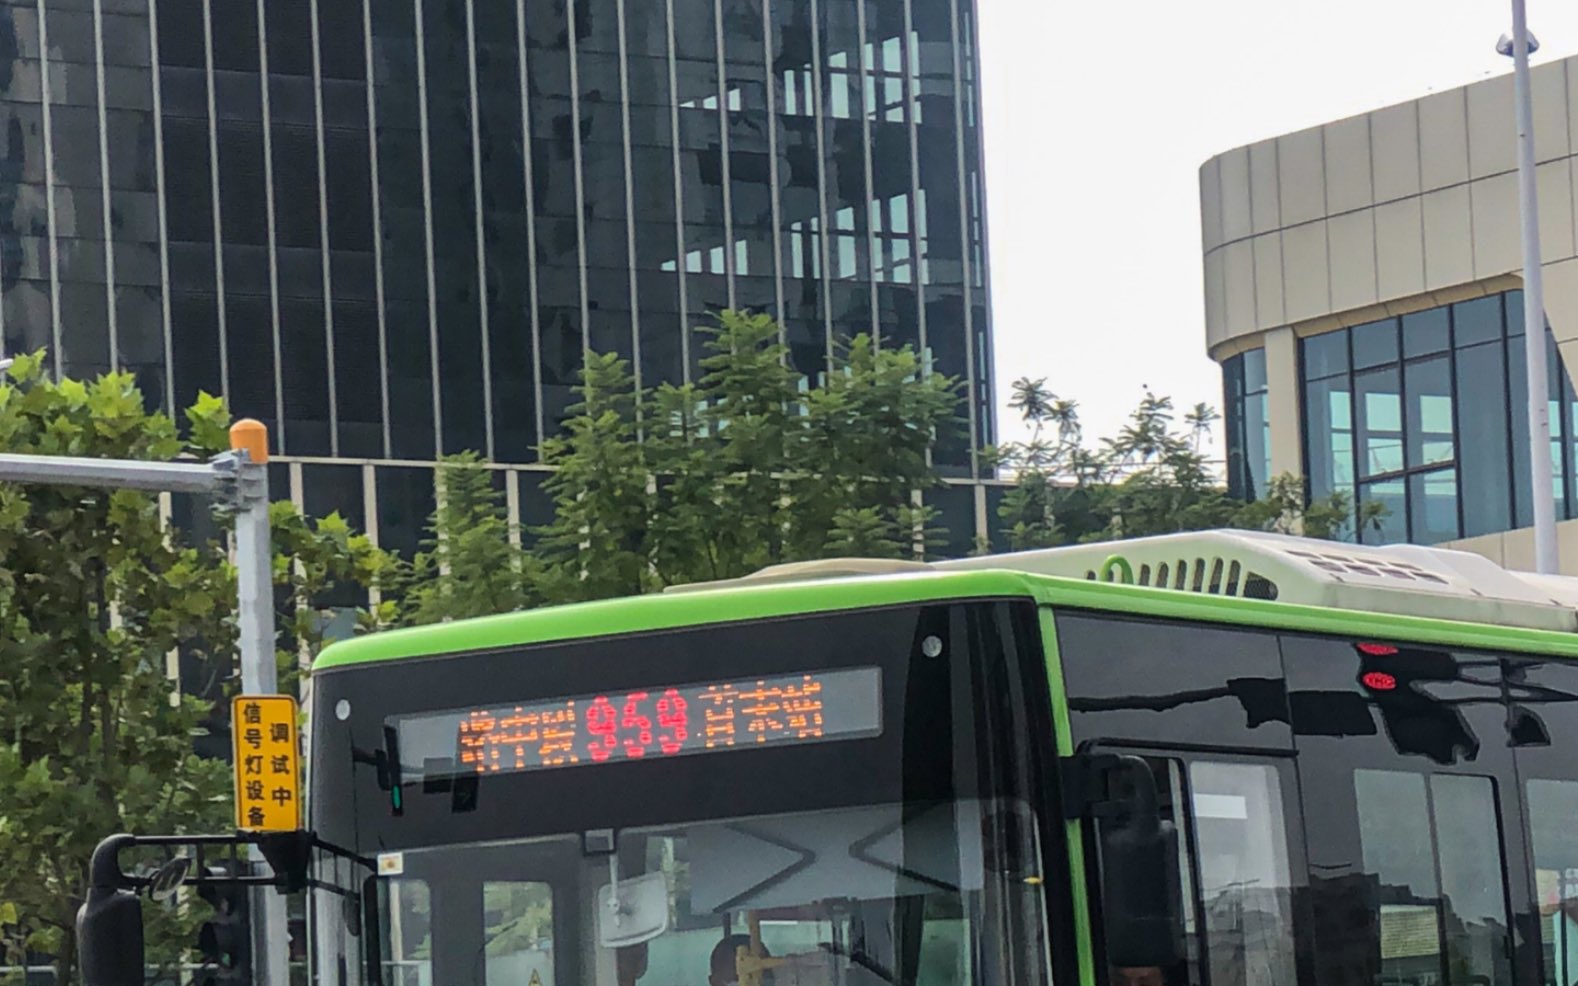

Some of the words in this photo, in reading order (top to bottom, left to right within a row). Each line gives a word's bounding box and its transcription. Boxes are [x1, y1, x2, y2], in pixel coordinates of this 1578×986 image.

[243, 702, 265, 827] 信号灯设备
[269, 723, 292, 807] 调试中
[585, 688, 688, 762] 959
